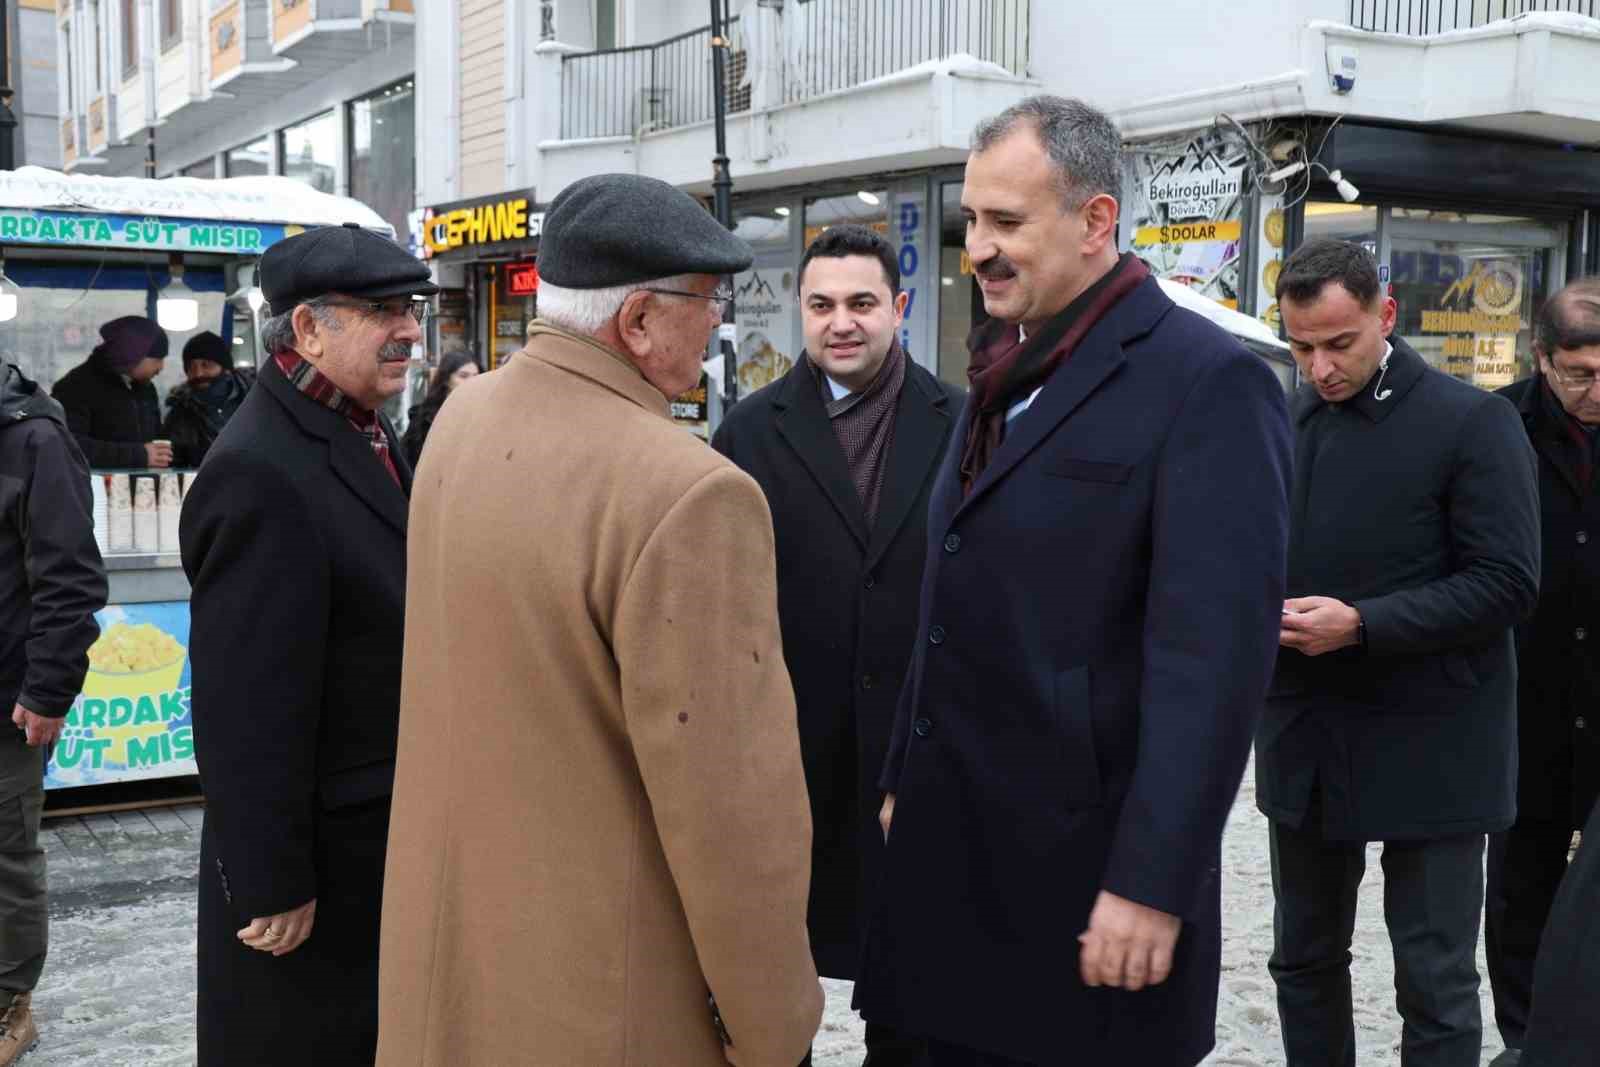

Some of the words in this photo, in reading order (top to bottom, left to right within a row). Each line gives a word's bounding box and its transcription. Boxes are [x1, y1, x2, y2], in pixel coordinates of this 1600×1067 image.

[1150, 178, 1237, 201] Bekiroğulları
[0, 216, 112, 241] RDAKTA
[125, 216, 178, 244] SÜT
[190, 226, 261, 249] MISIR
[424, 198, 528, 252] CEPHANE
[1171, 224, 1216, 241] DOLAR
[671, 402, 699, 418] STORE
